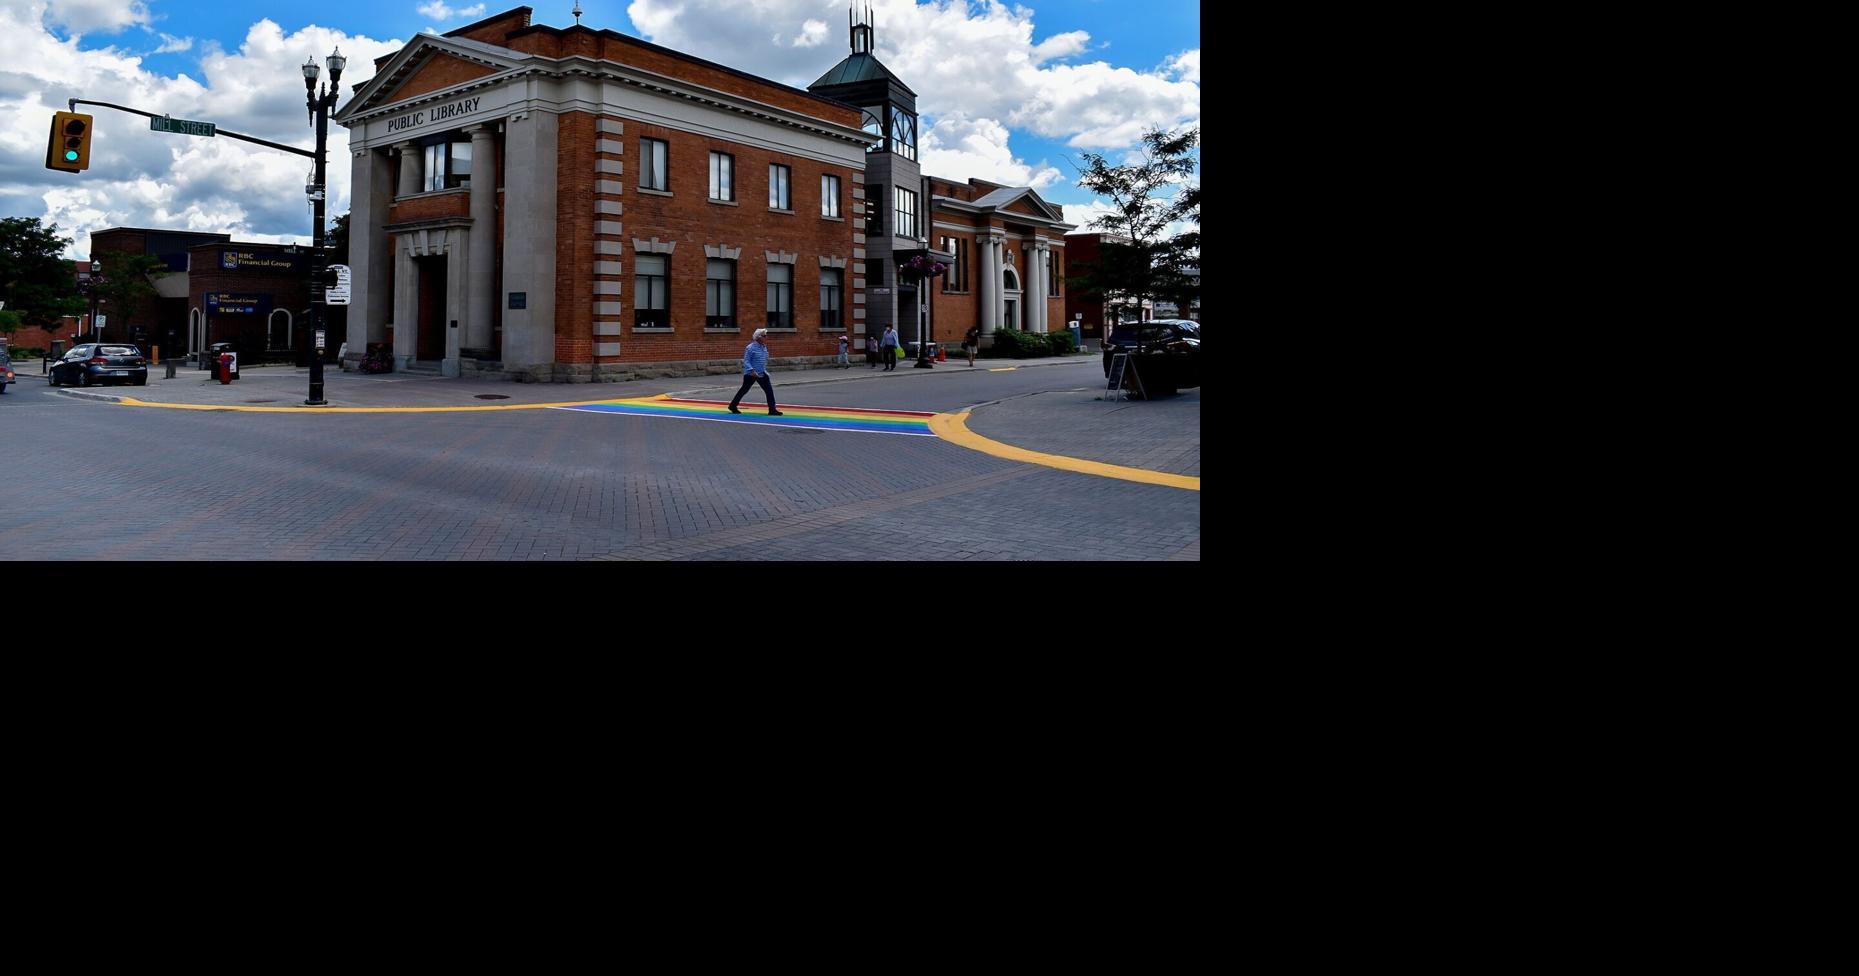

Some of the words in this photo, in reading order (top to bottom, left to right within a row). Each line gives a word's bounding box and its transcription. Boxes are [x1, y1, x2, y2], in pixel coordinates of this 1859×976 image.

[387, 112, 424, 133] PUBLIC
[430, 97, 480, 122] LIBRARY
[152, 117, 174, 132] MILL
[180, 120, 214, 136] STREET
[271, 260, 291, 268] Group
